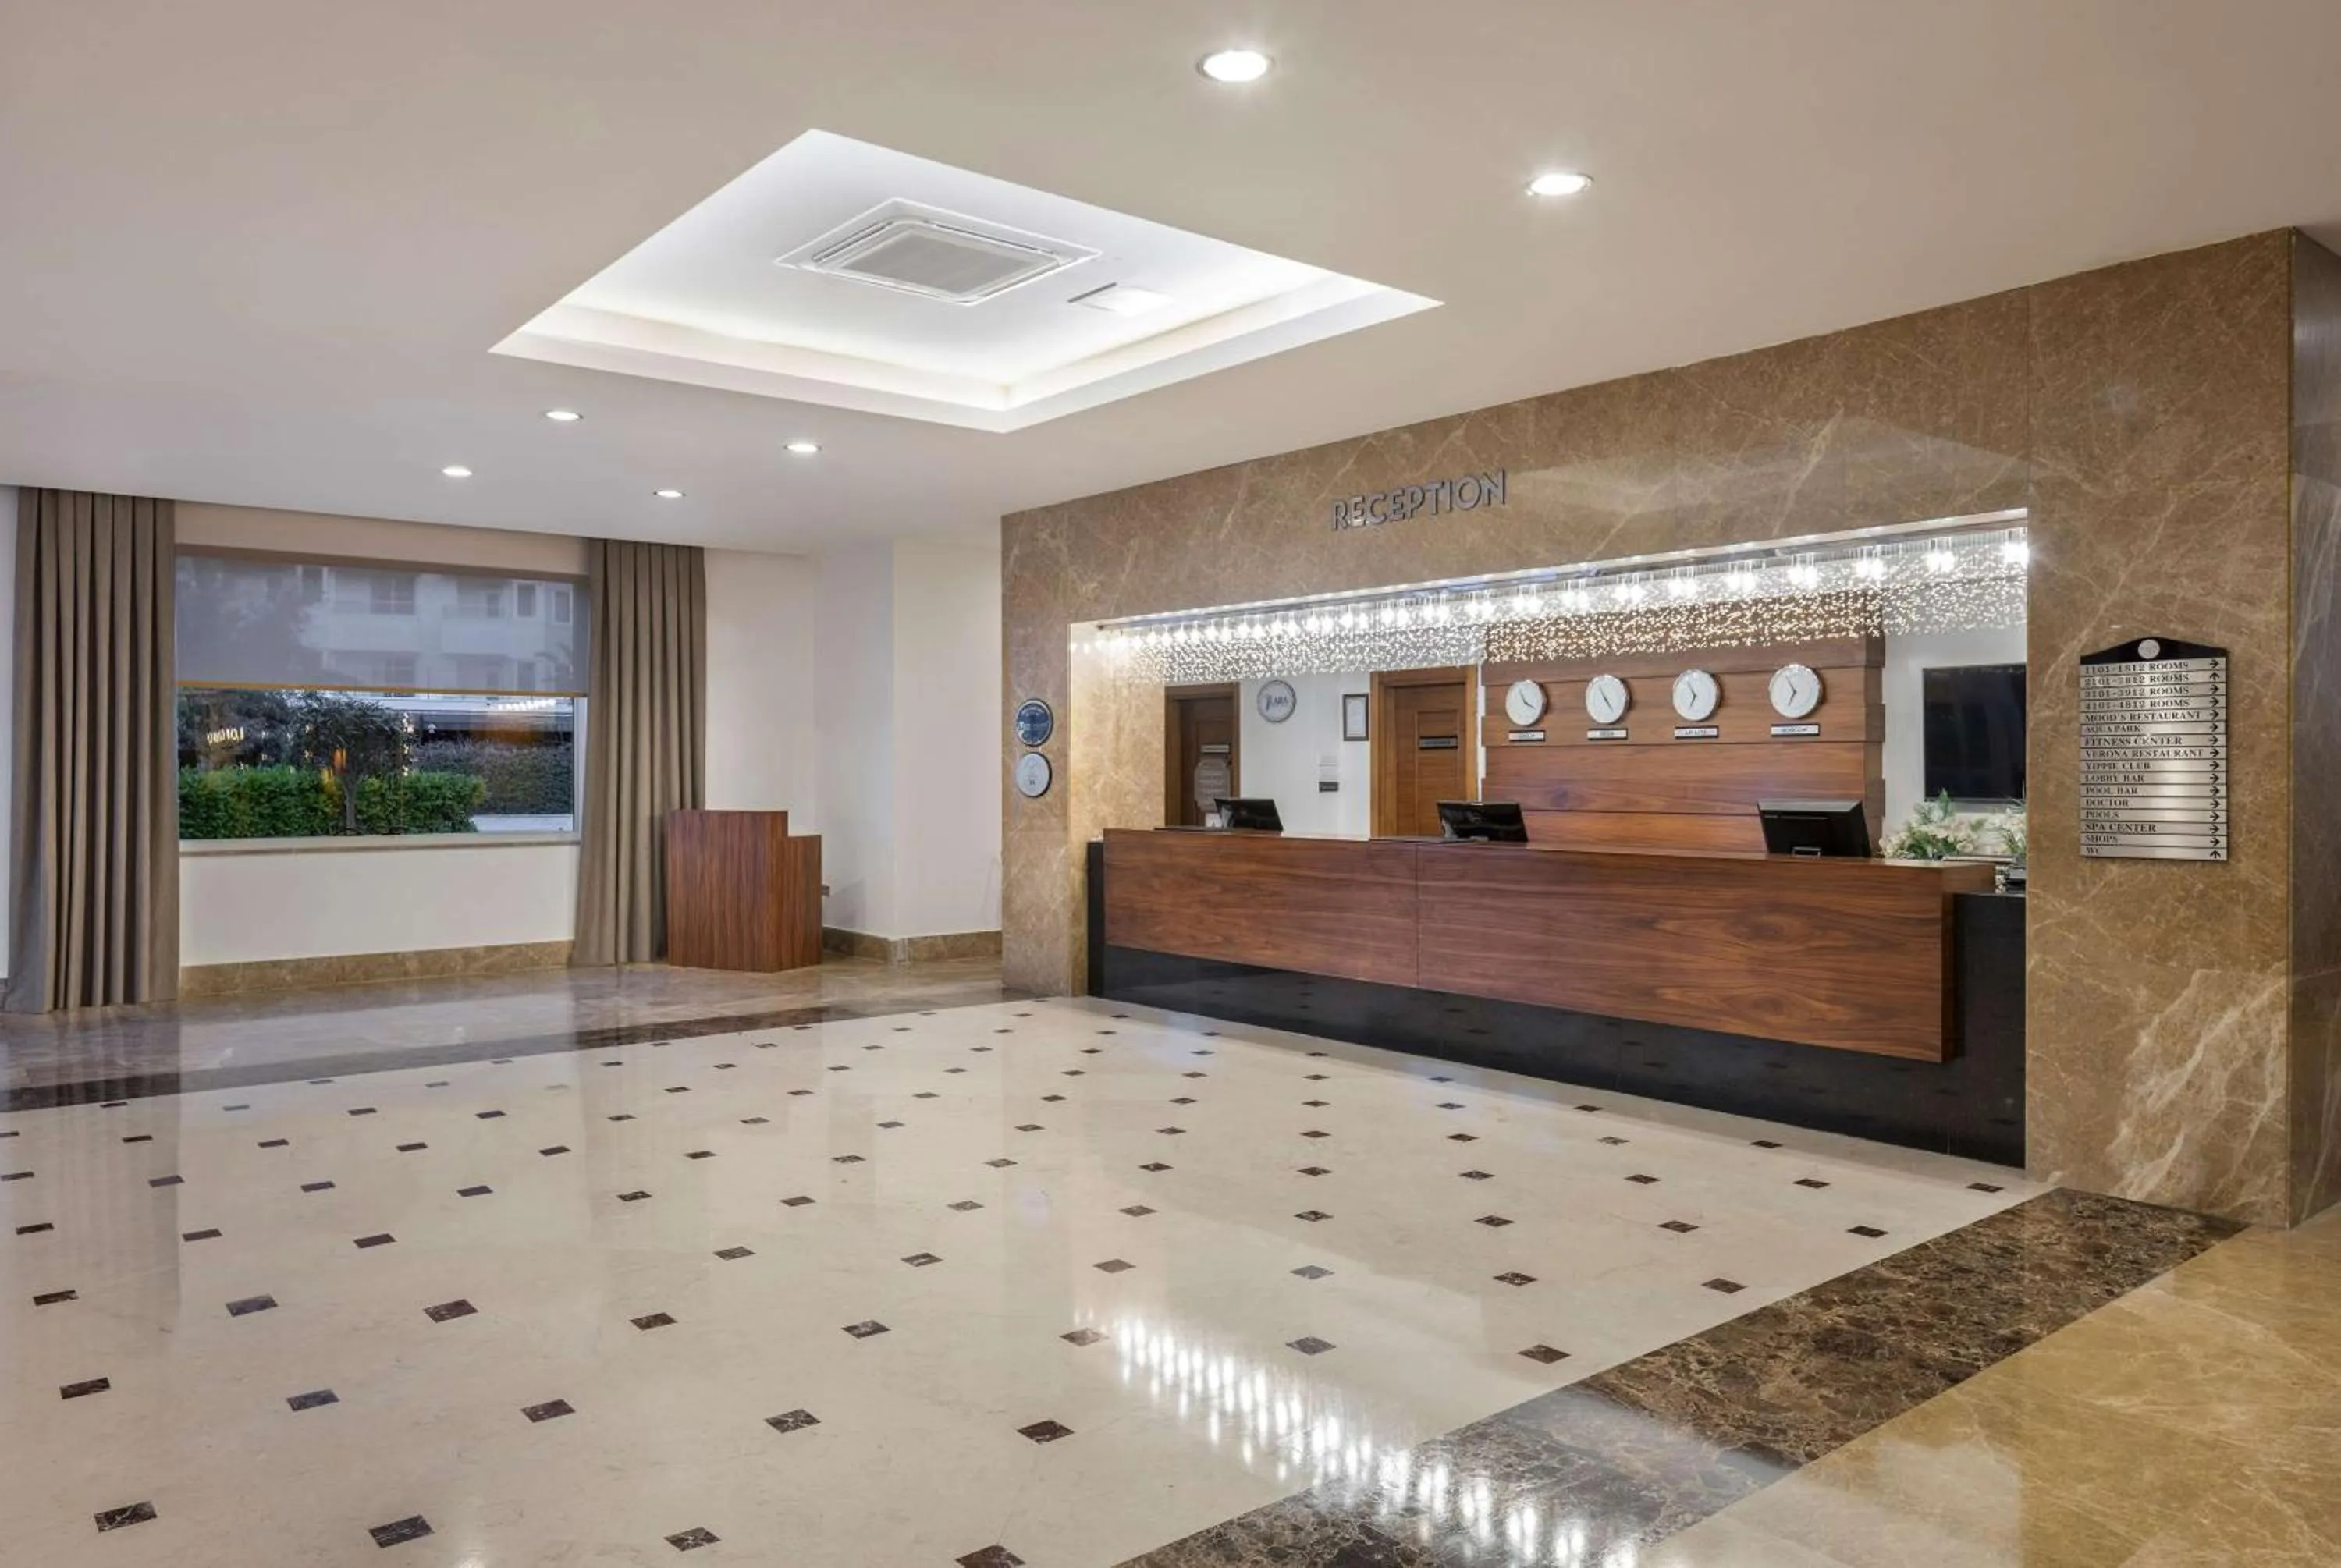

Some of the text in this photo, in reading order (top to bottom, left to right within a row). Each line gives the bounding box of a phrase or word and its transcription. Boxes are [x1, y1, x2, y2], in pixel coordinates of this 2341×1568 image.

[1331, 468, 1506, 531] RECEPTION
[2150, 673, 2189, 683] ROOMS
[2150, 686, 2189, 695] ROOMS
[2150, 699, 2190, 708] ROOMS
[2130, 711, 2201, 720] RESTAURANT
[2085, 737, 2131, 746] FITNESS
[2109, 824, 2157, 832] CENTER
